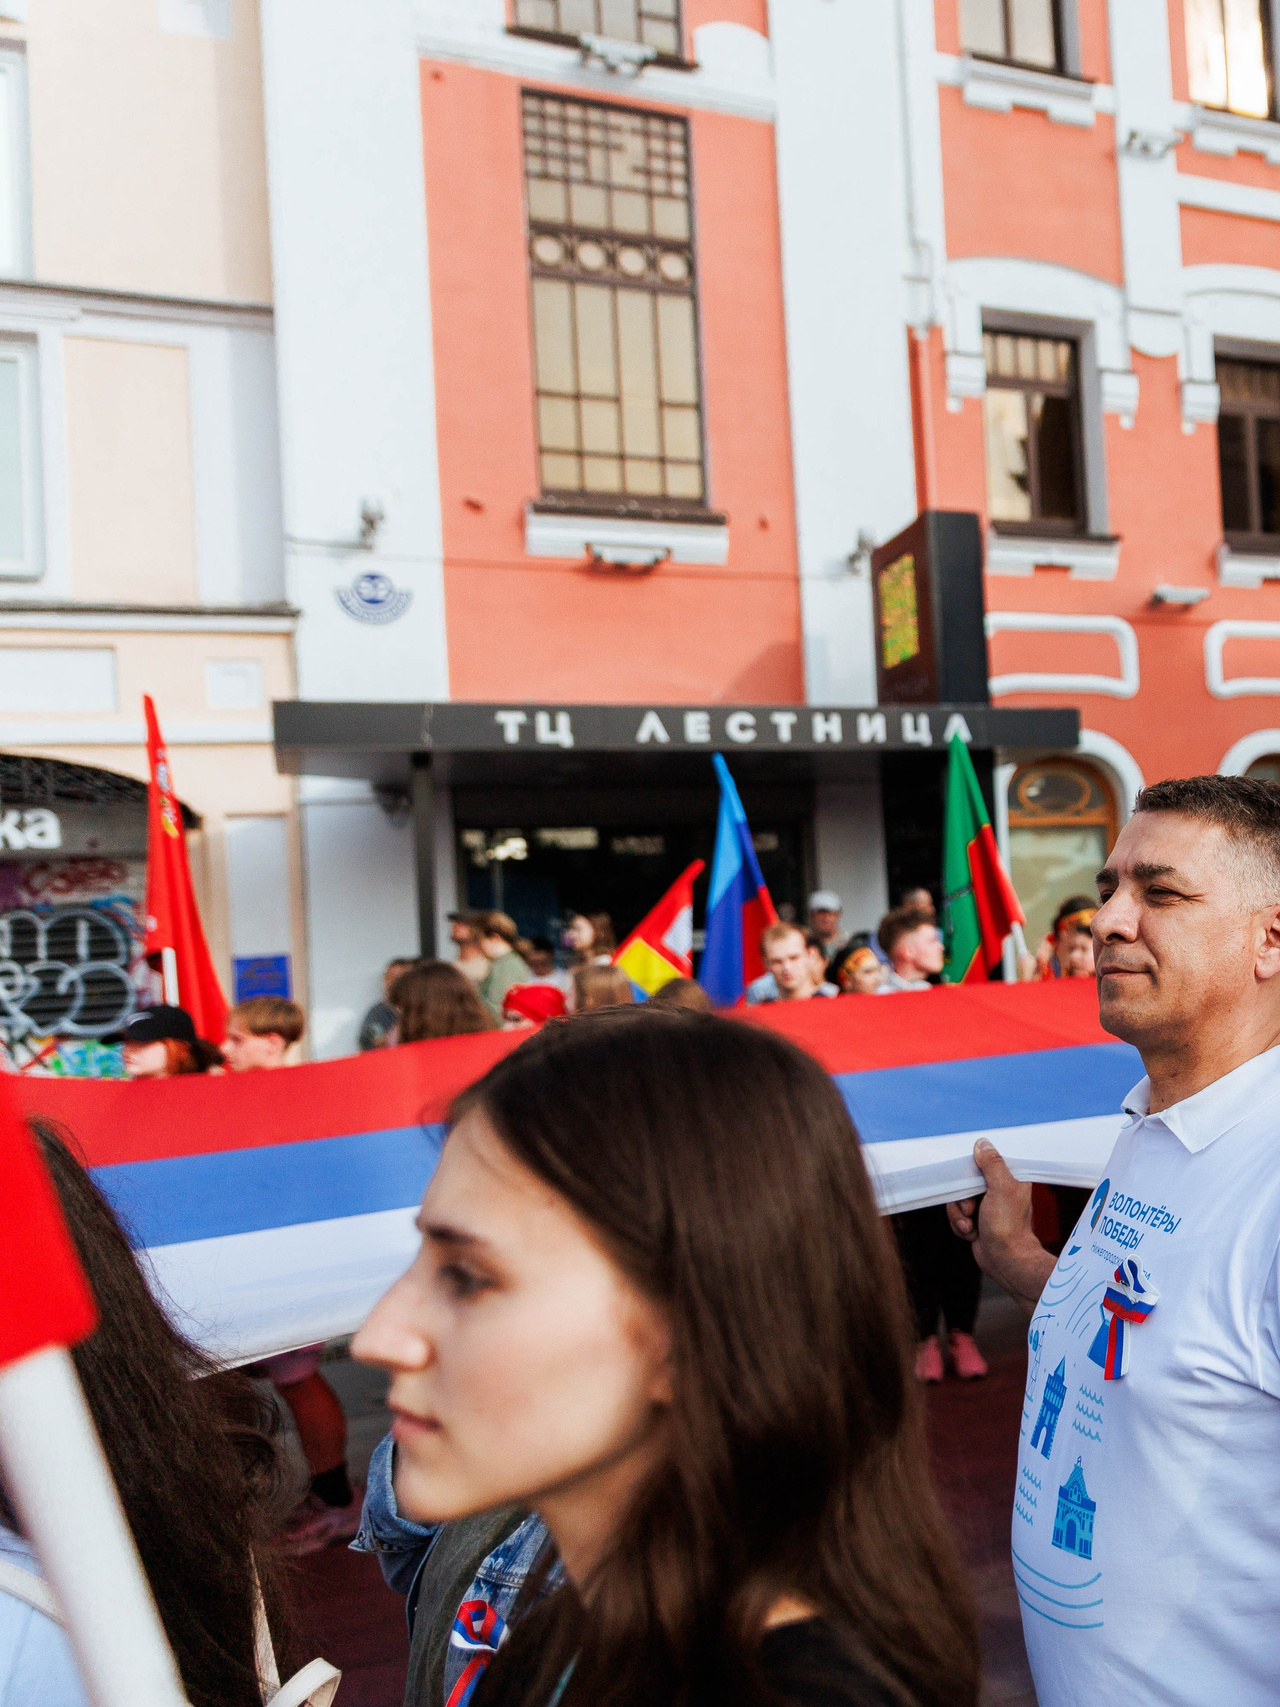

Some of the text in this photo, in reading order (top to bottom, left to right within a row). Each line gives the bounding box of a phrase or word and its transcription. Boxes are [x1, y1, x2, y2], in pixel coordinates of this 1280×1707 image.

[495, 710, 973, 748] ТЦ ЛЕСТНИЦА
[1108, 1191, 1182, 1235] ВОЛОНТЁРЫ
[1098, 1215, 1145, 1250] ПОБЕДЫ
